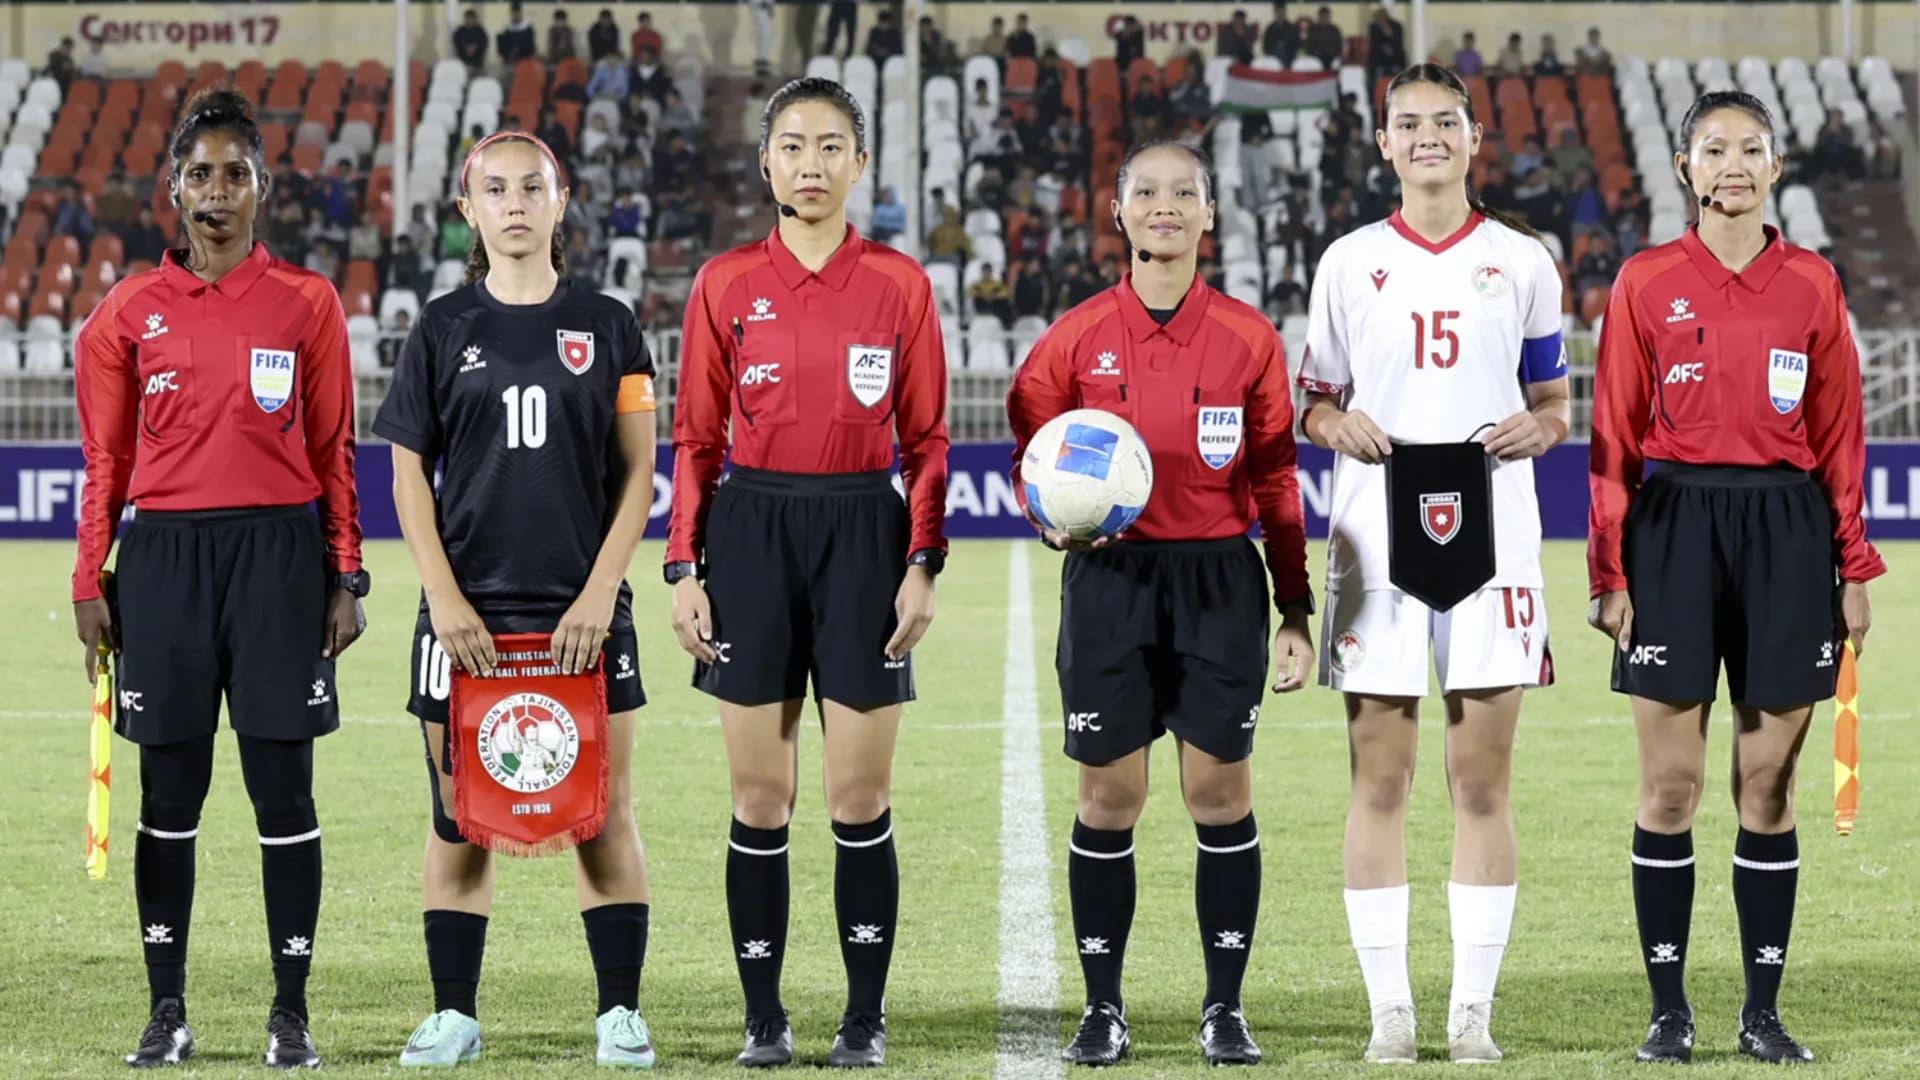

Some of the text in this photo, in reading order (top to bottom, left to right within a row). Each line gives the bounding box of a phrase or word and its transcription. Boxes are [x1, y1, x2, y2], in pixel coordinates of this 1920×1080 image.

[79, 14, 280, 52] Сектори 17
[747, 313, 777, 321] KELME
[1665, 312, 1696, 323] KELME
[142, 326, 169, 340] KELME
[1411, 310, 1460, 369] 15
[255, 353, 290, 370] FIFA
[459, 360, 487, 373] KELME
[855, 353, 886, 370] AFC
[1091, 367, 1121, 376] KELME
[1773, 353, 1804, 373] FIFA
[145, 370, 180, 395] AFC
[740, 363, 782, 385] AFC
[1664, 362, 1705, 384] AFC
[855, 383, 883, 391] REFEREE
[502, 385, 547, 449] 10
[1202, 411, 1238, 426] FIFA
[1201, 435, 1236, 444] REFEREE
[1502, 586, 1535, 628] 15
[497, 651, 551, 661] TAJIKISTAN
[1629, 645, 1667, 665] AFC
[419, 633, 451, 700] 10
[521, 665, 561, 677] FEDERAT
[521, 695, 577, 742] TAJIKISTAN
[1068, 712, 1102, 732] AFC
[480, 708, 508, 783] FEDERATION
[519, 753, 576, 790] FOOTBALL
[512, 804, 530, 815] ESTD
